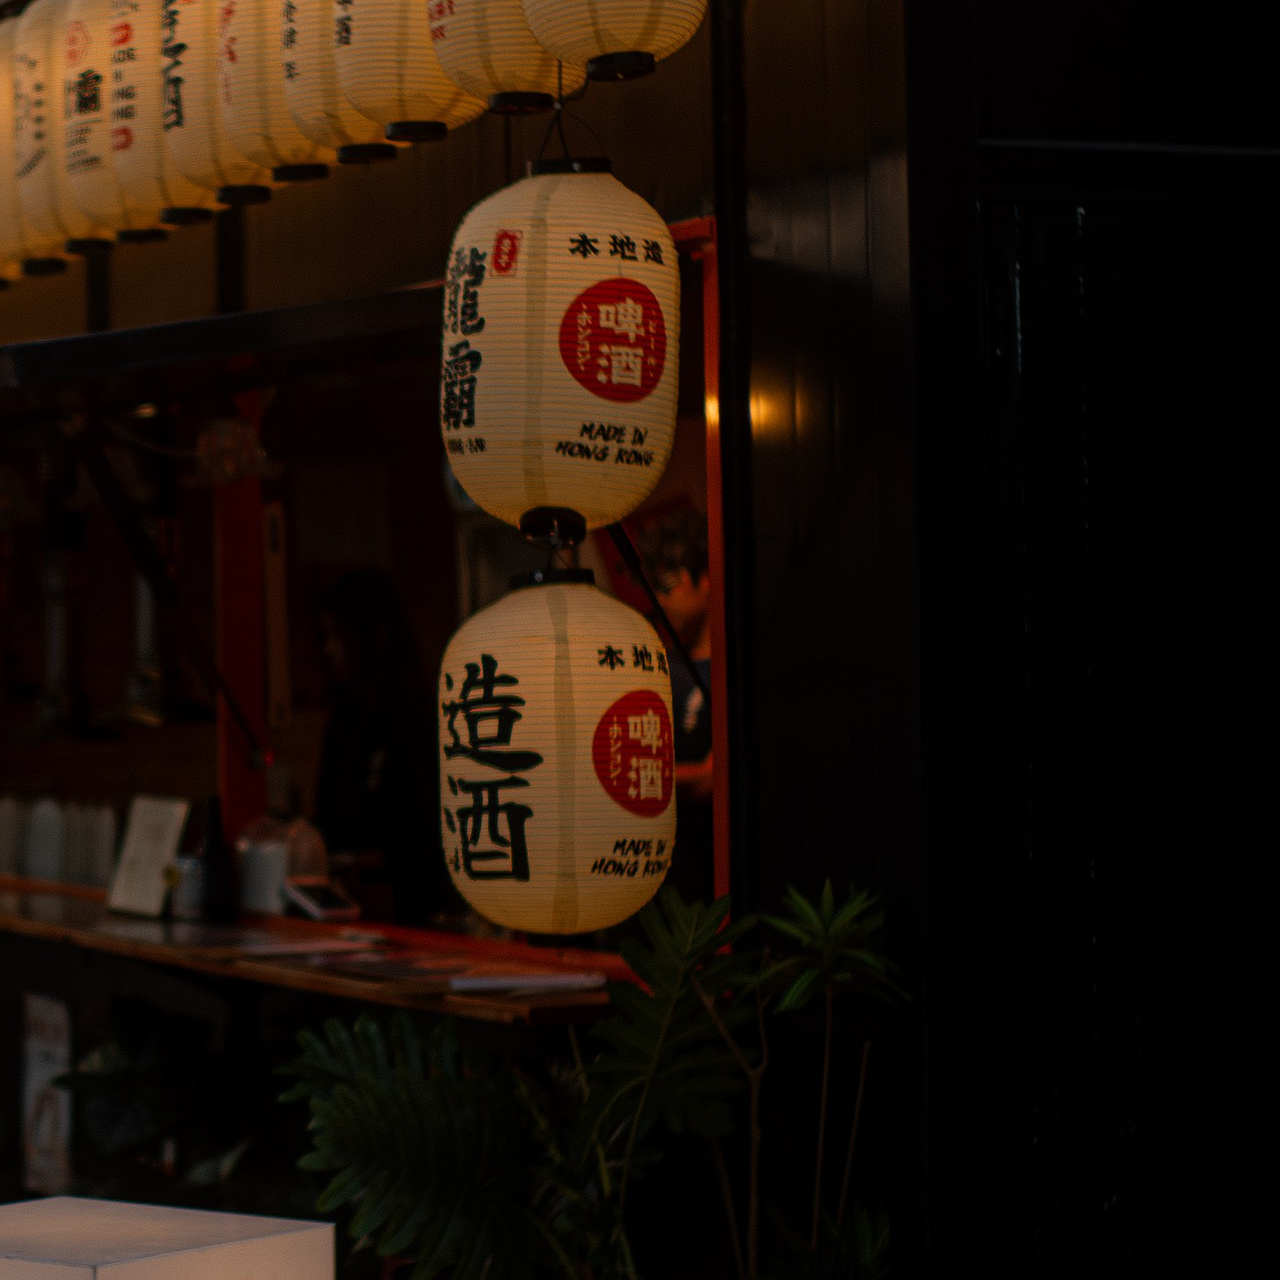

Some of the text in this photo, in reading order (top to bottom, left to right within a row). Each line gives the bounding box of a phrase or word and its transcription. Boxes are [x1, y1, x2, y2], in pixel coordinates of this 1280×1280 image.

[568, 232, 665, 266] 本地造
[597, 295, 646, 388] 啤酒
[580, 422, 649, 447] MADE IN
[555, 440, 655, 467] HONG KONG
[441, 652, 544, 882] 造酒
[627, 707, 663, 801] 啤酒
[612, 837, 653, 857] MADE
[590, 856, 639, 878] HONG
